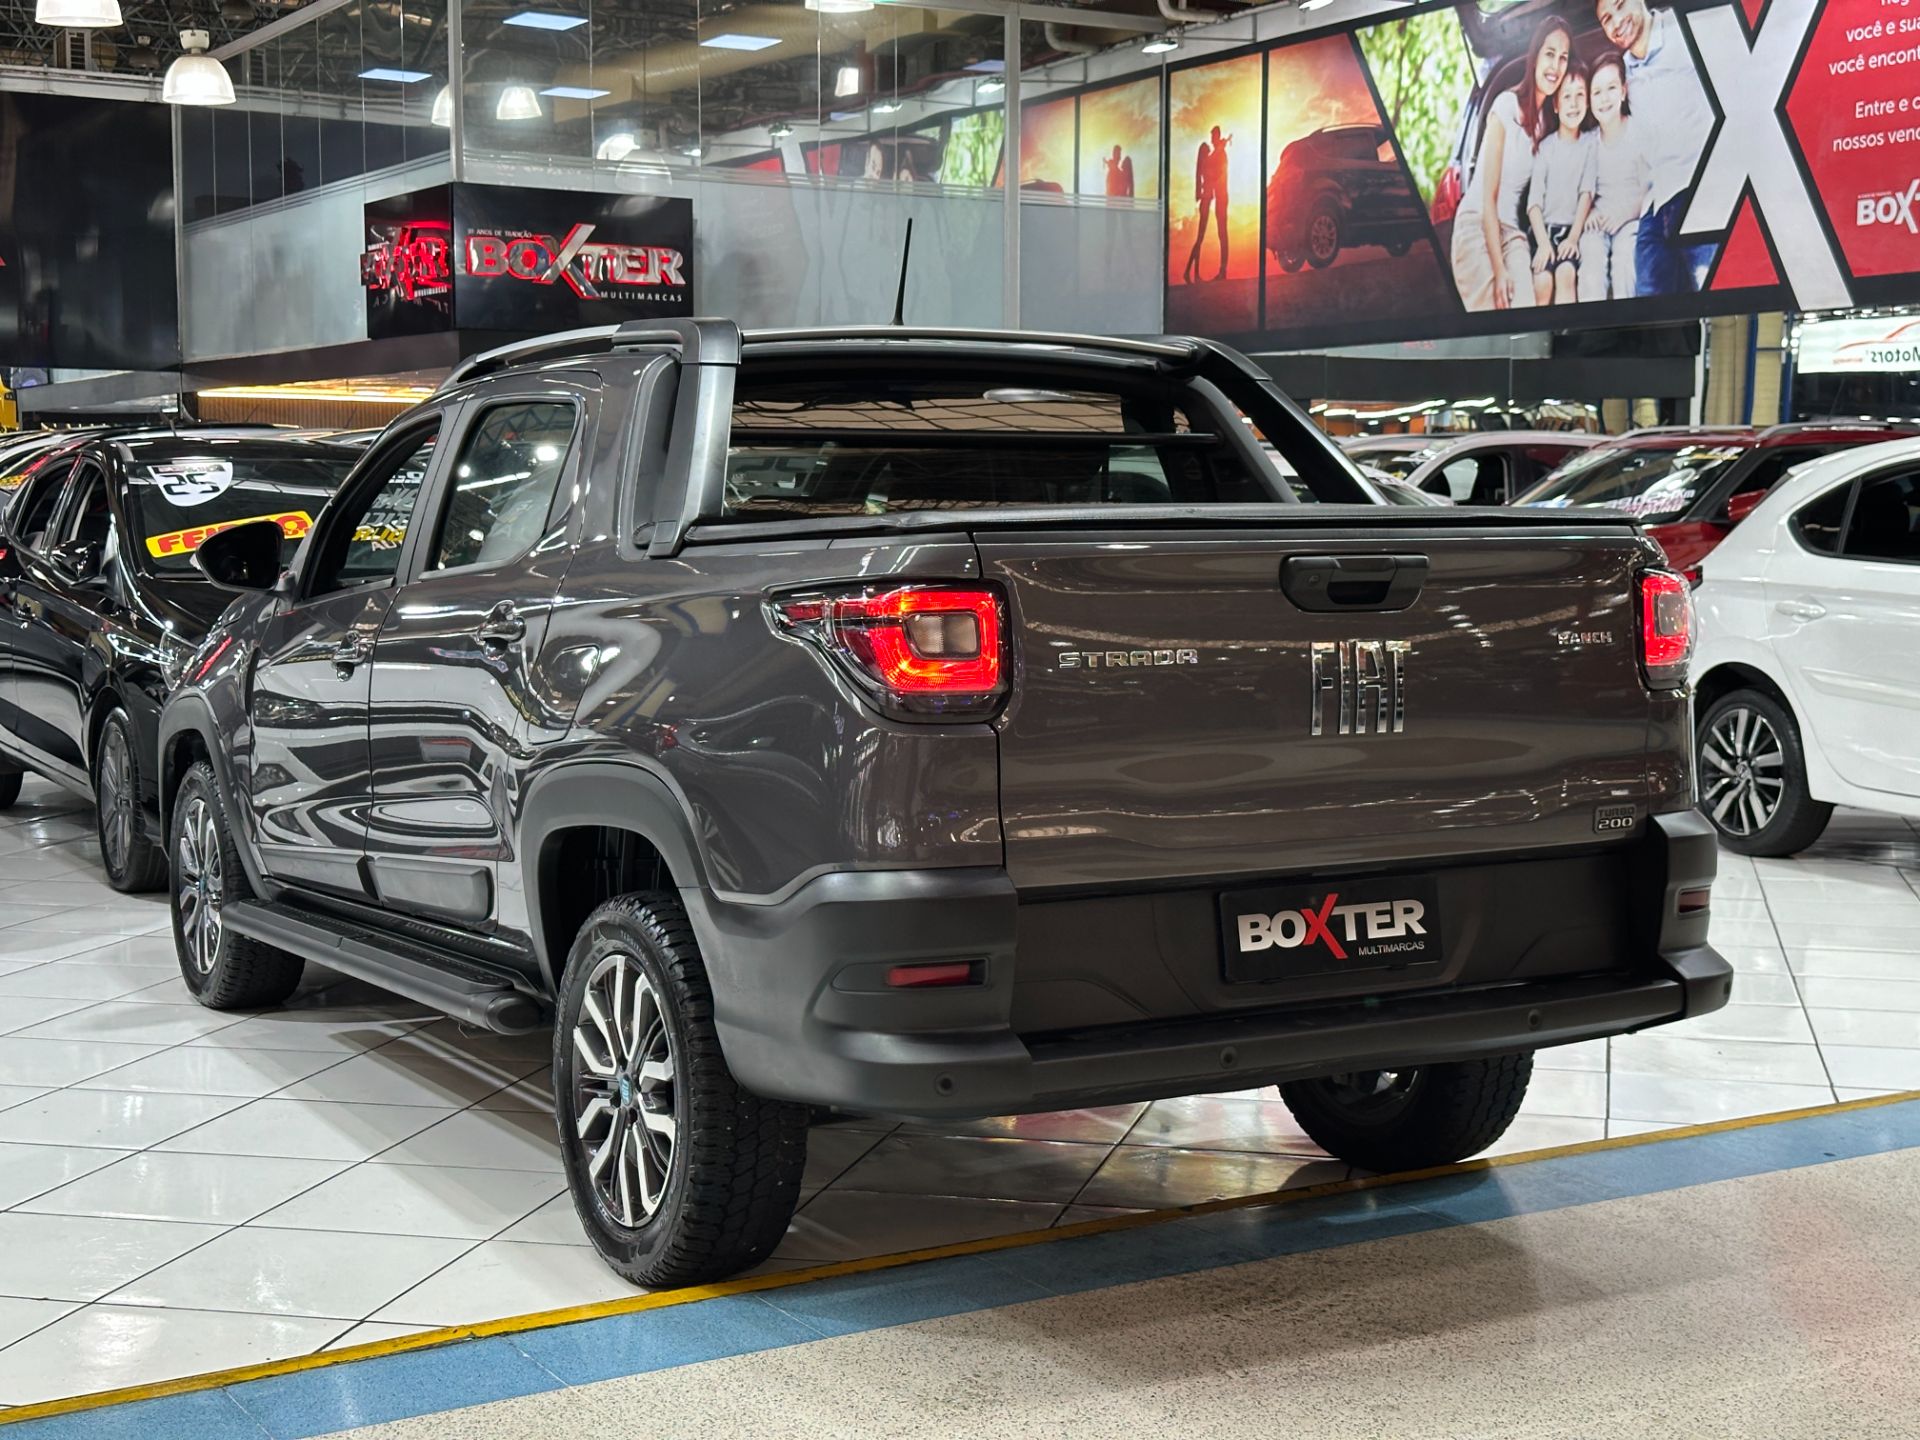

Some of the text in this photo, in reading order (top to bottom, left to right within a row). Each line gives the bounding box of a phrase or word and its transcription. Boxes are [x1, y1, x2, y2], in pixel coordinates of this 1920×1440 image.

[1845, 20, 1882, 42] você
[1885, 21, 1896, 35] e
[1828, 55, 1865, 76] você
[1855, 100, 1895, 118] Entre
[1898, 98, 1909, 112] e
[1833, 131, 1884, 152] nossos
[466, 223, 686, 300] BOXTER
[600, 290, 683, 302] MULTIMARCAS
[160, 473, 220, 496] 25
[1557, 631, 1613, 645] RANCH
[1058, 648, 1199, 669] STRADA
[1311, 639, 1412, 736] FIAT
[1598, 806, 1635, 817] TURBO
[1598, 817, 1633, 829] 200
[1237, 892, 1427, 960] BOXTER
[1358, 941, 1425, 956] MULTIMARCAS
